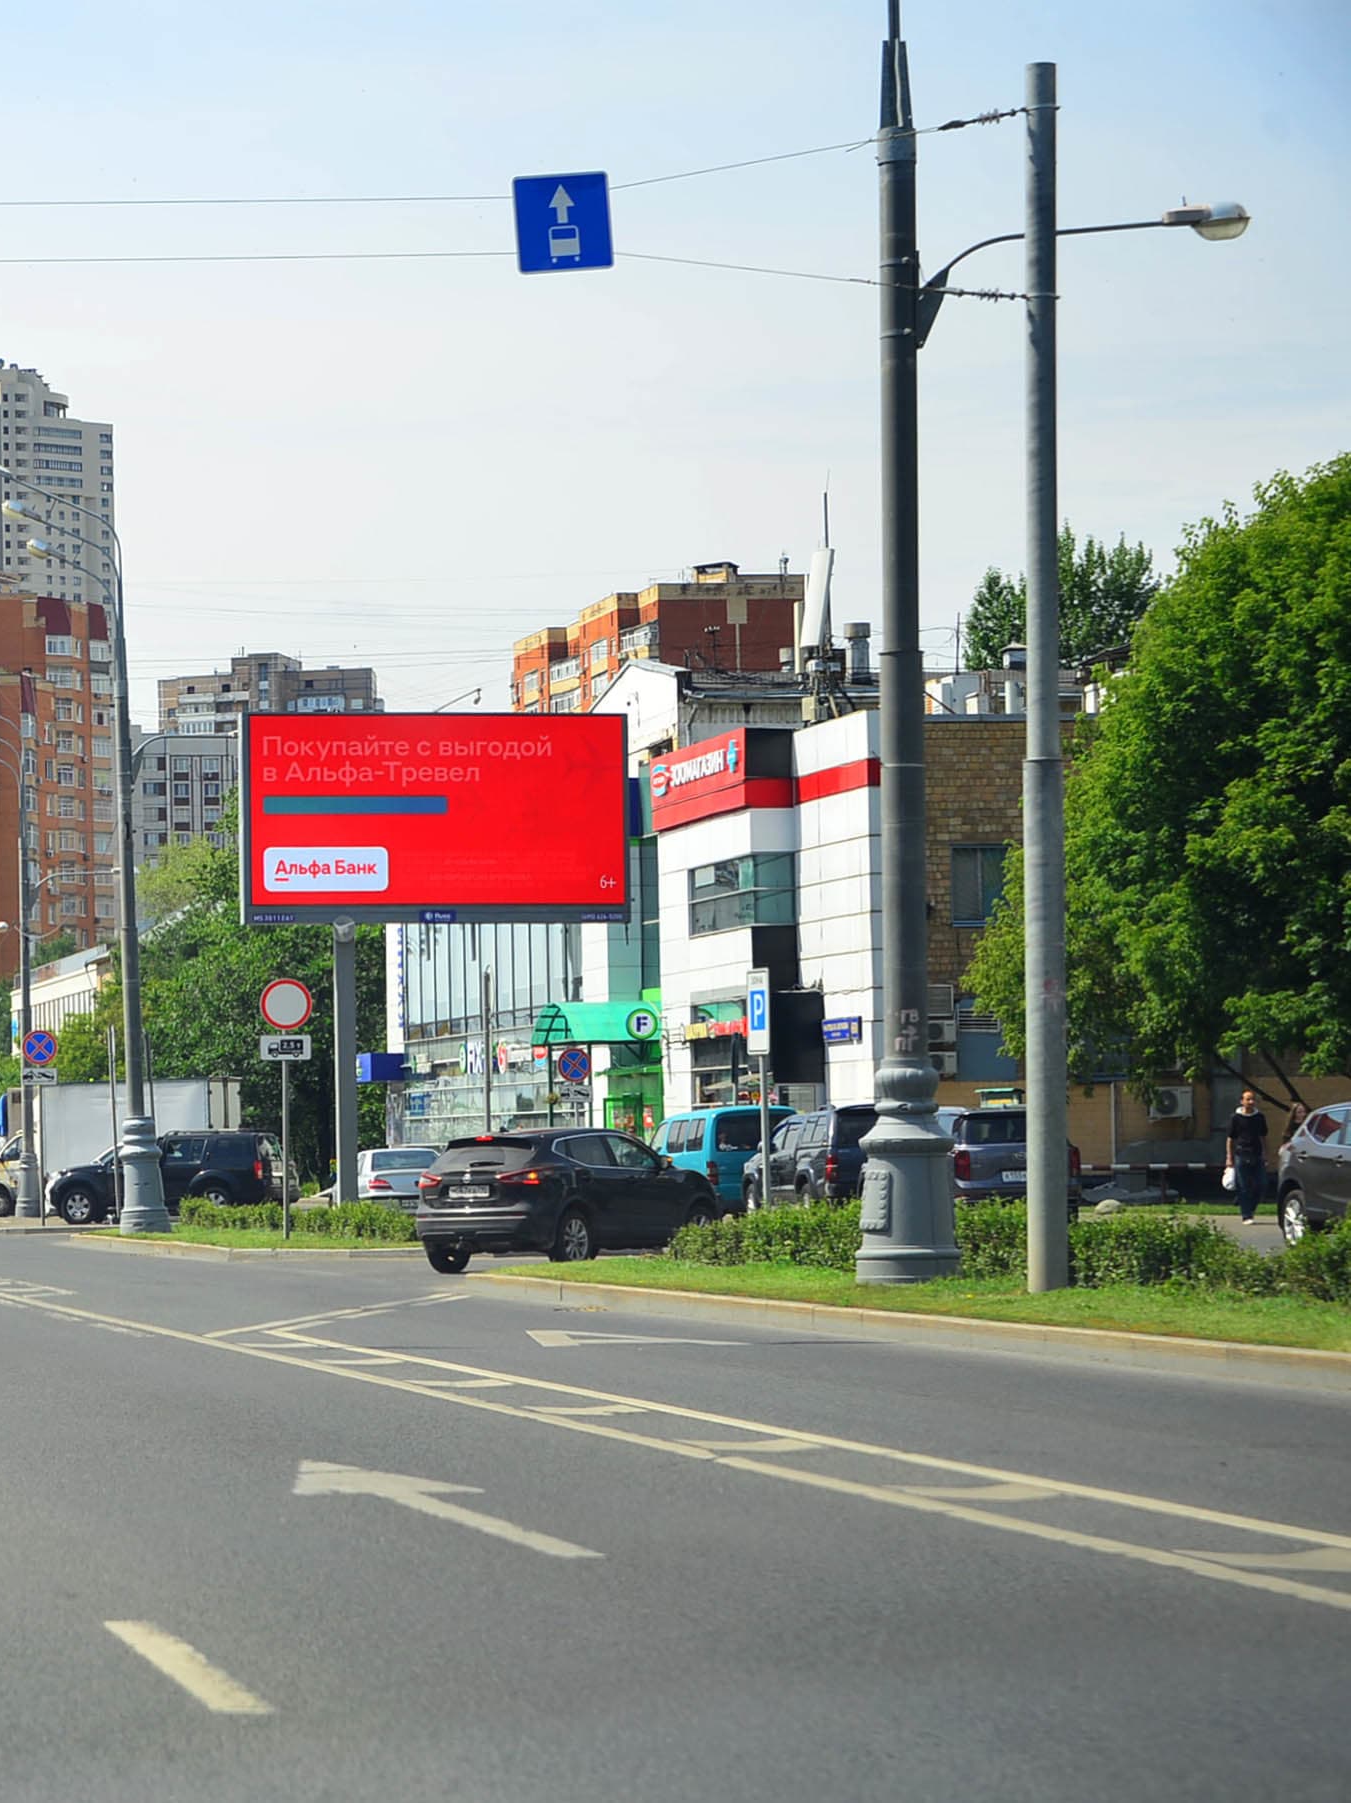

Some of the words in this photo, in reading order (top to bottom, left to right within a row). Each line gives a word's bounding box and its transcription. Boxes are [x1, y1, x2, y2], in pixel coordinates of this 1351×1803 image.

[262, 735, 410, 761] Покупайте
[417, 743, 431, 757] с
[438, 736, 552, 760] выгодой
[262, 767, 277, 782] в
[285, 761, 480, 787] Альфа-Тревел
[275, 860, 331, 878] Альфа
[334, 859, 377, 875] Банк
[600, 875, 617, 889] 6+
